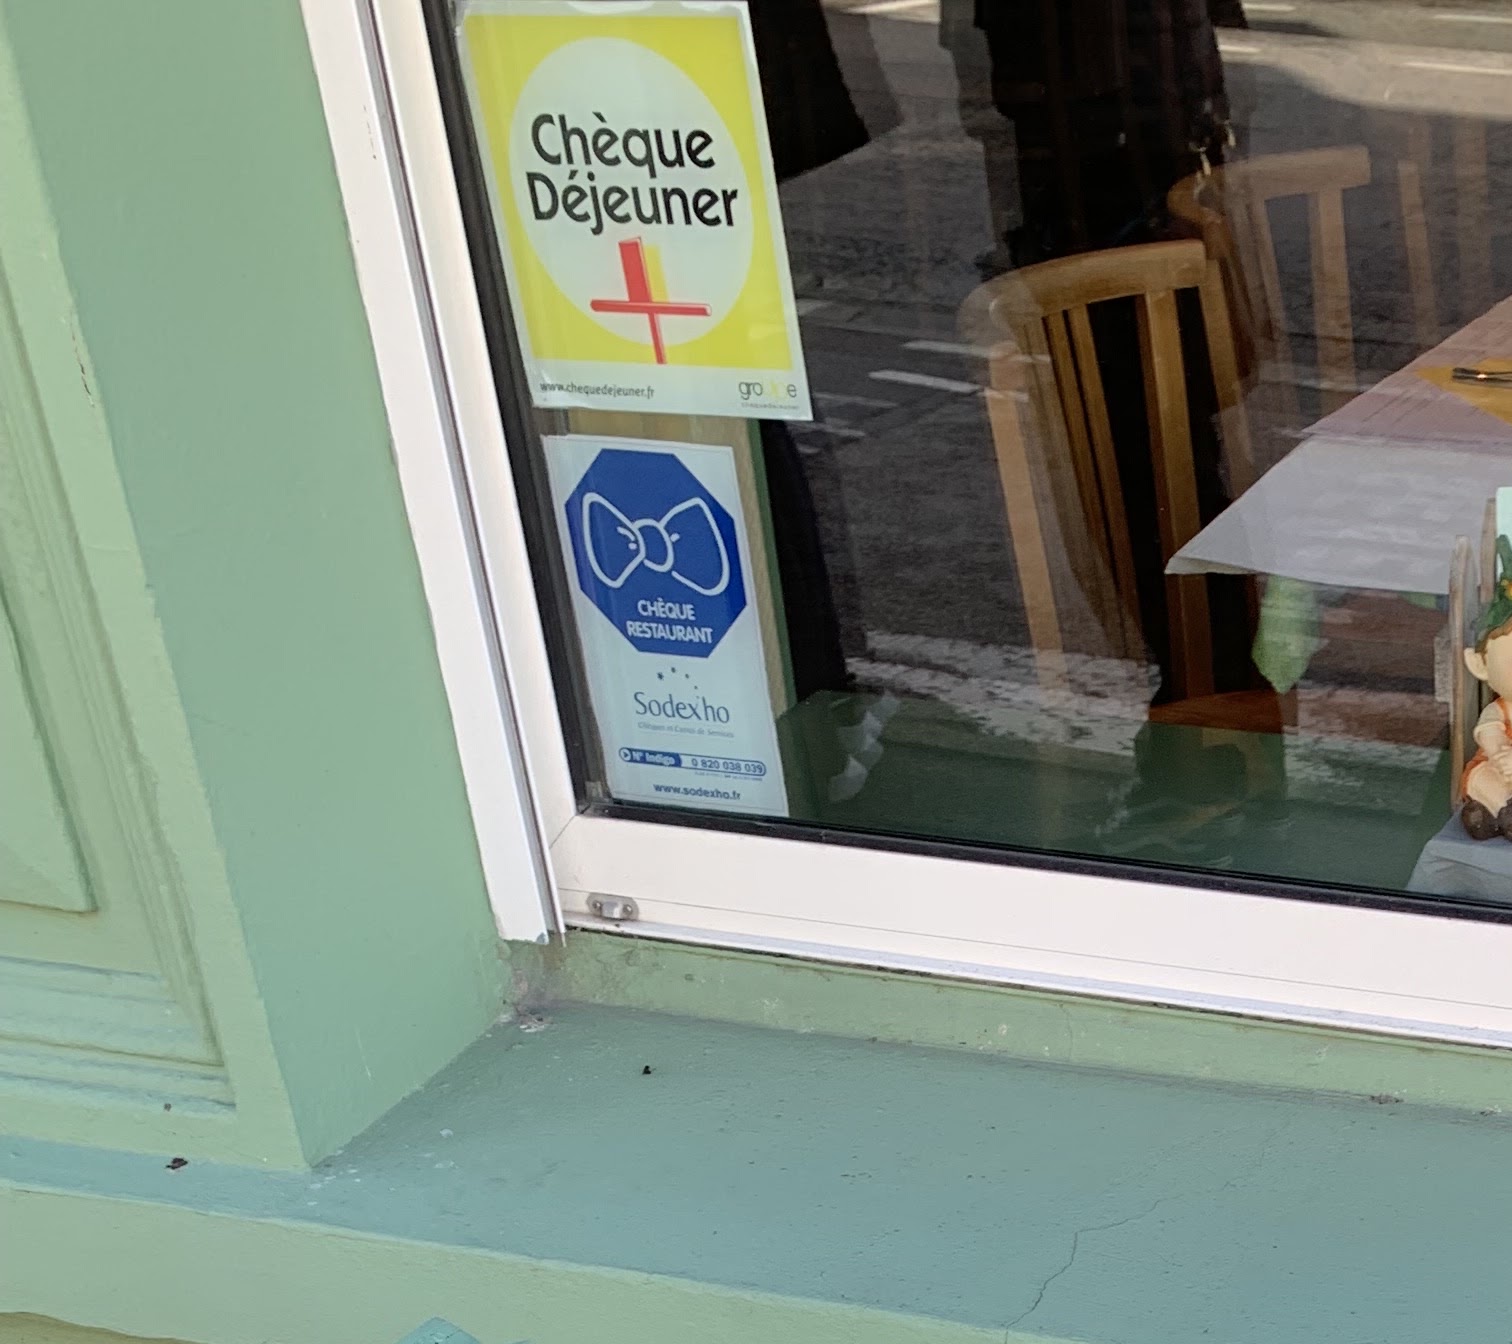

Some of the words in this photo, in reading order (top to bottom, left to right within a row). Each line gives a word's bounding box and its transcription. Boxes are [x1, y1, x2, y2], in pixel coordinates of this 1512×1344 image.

[531, 111, 716, 179] Chèque
[526, 170, 738, 236] Déjeuner
[540, 381, 655, 399] www.chequedejeuner.fr
[637, 597, 696, 620] CHÈQUE
[626, 620, 713, 643] RESTAURANT
[634, 691, 730, 723] Sodexho
[701, 759, 720, 770] 820
[723, 760, 742, 772] 038
[744, 762, 763, 774] 039
[653, 783, 741, 800] www.sodexho.fr
